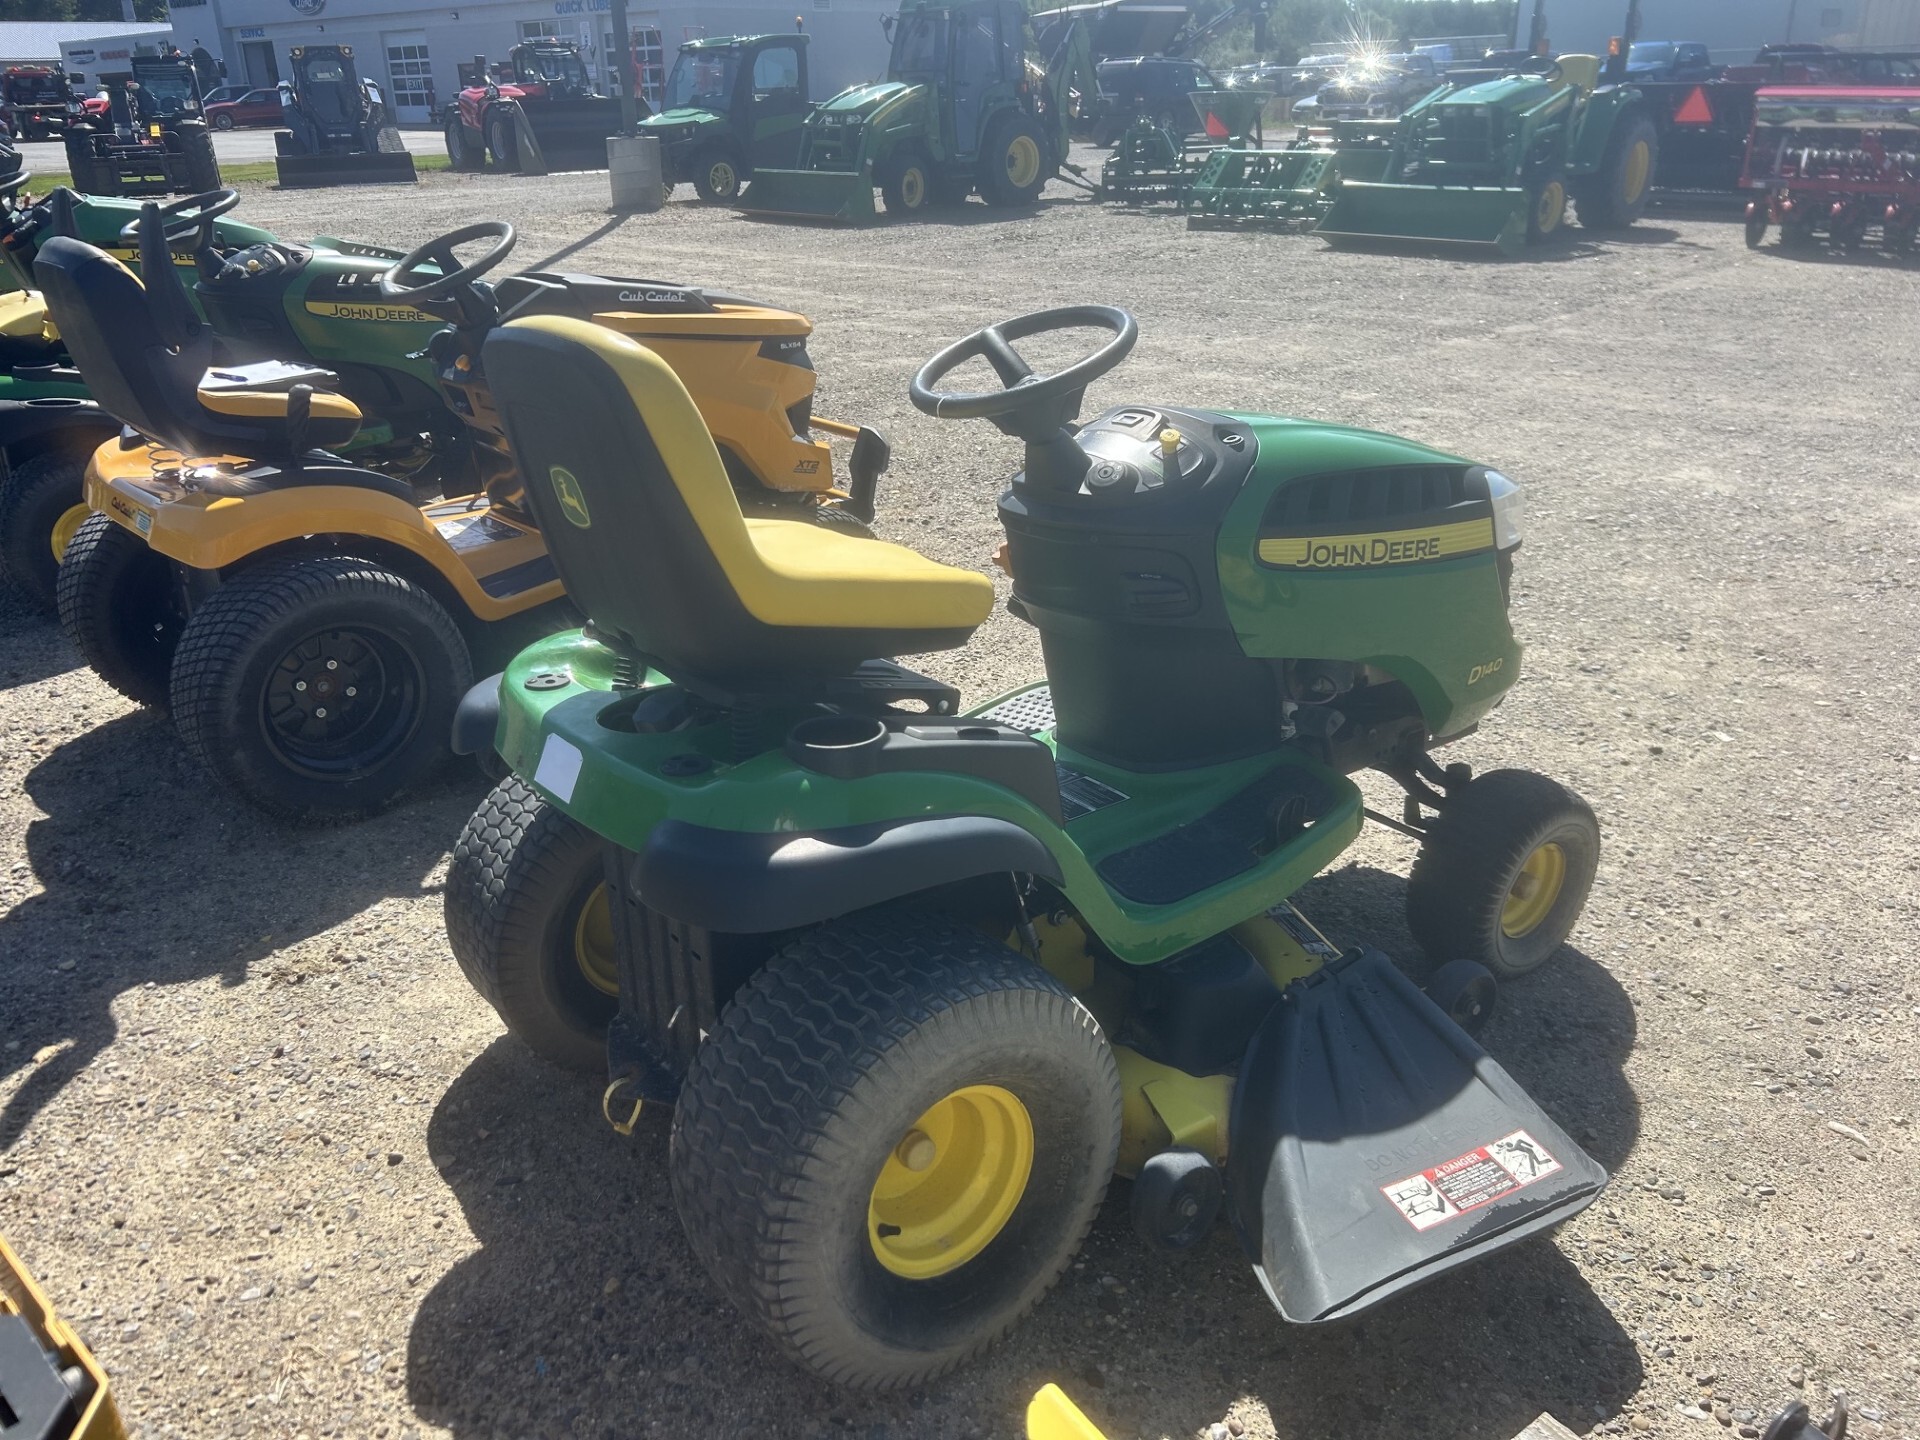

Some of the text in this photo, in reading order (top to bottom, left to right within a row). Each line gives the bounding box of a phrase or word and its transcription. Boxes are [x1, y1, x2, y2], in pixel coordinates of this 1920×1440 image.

[555, 1, 583, 14] QUICK
[240, 28, 265, 38] SERVICE
[408, 79, 423, 89] EXIT
[618, 290, 686, 303] Cub Cadet
[329, 304, 426, 321] JOHN DEERE
[1296, 537, 1441, 566] JOHN DEERE
[1467, 657, 1504, 686] D140
[1364, 1154, 1393, 1172] DO
[1390, 1136, 1424, 1163] NOT
[1441, 1152, 1481, 1173] DANGER
